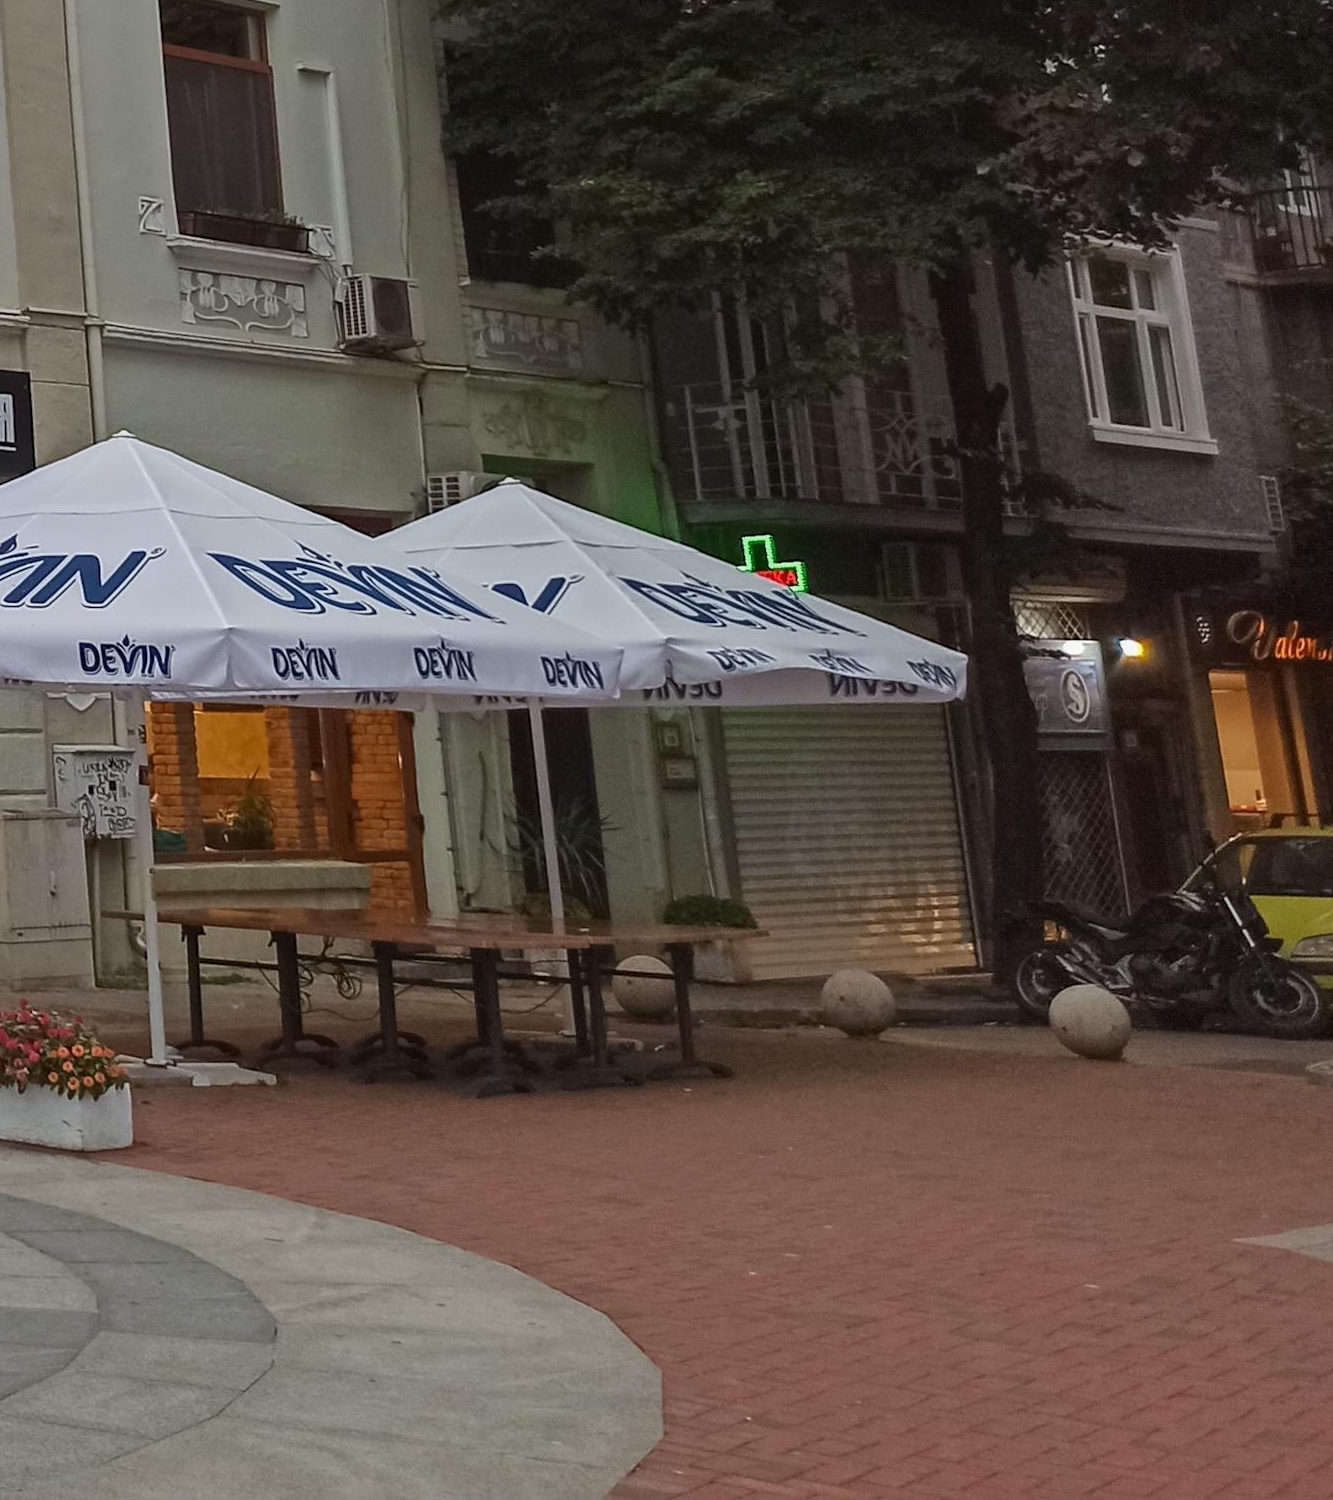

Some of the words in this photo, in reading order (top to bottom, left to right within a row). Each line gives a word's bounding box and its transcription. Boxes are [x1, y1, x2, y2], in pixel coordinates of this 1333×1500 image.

[207, 548, 505, 625] DEVIN
[618, 574, 867, 637] DEVIN
[78, 637, 174, 678] DEVIN
[270, 642, 340, 681] DEVIN
[413, 642, 477, 681] DEVIN
[541, 653, 605, 689] DEVIN
[707, 646, 777, 672] DEVIN
